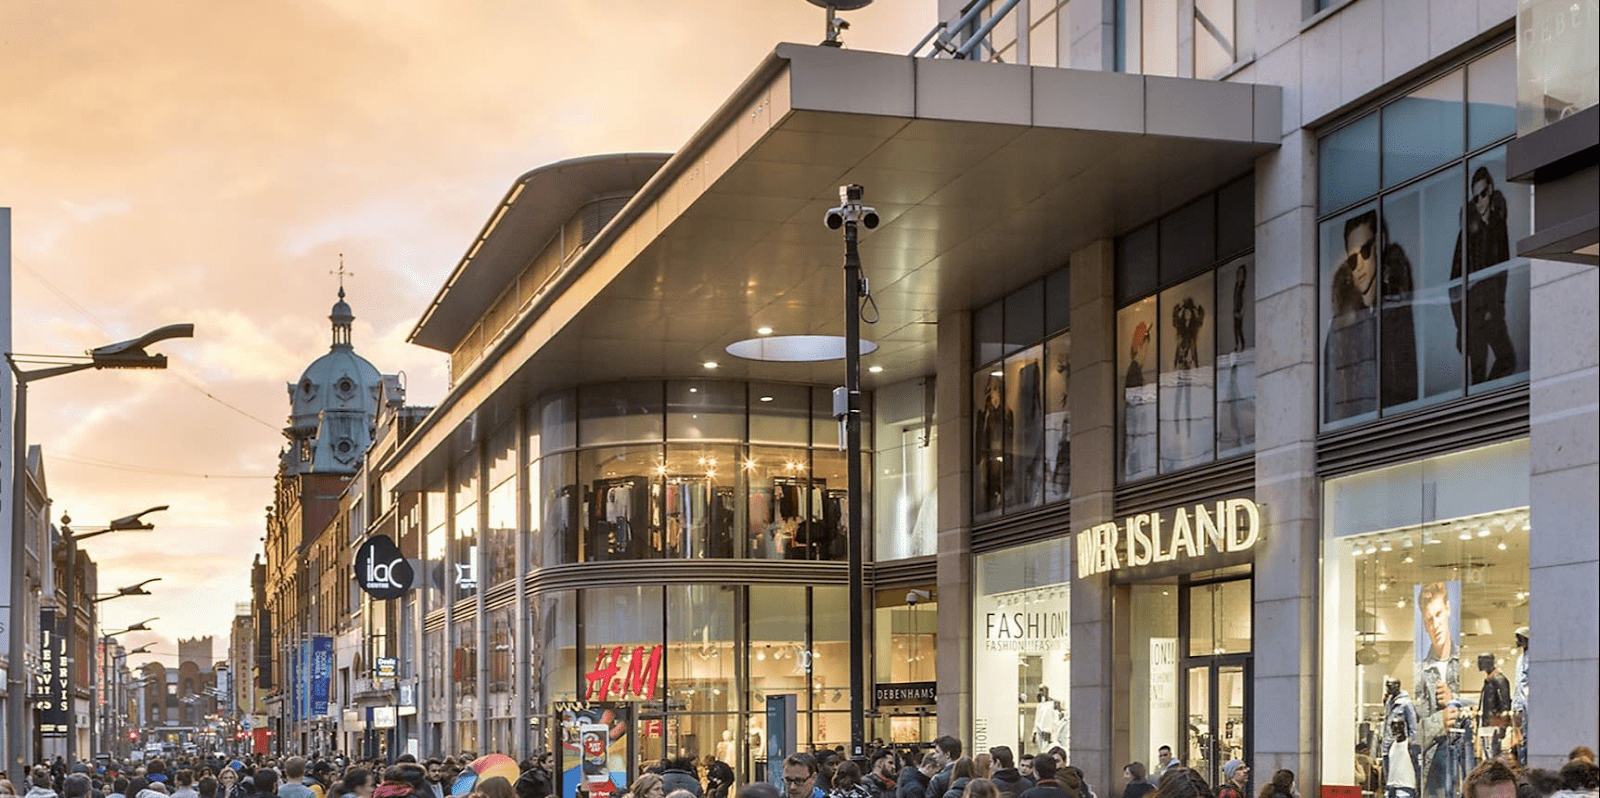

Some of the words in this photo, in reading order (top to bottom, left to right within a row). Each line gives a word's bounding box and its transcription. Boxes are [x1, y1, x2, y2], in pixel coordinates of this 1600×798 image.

[1126, 498, 1260, 567] ISLAND
[366, 545, 403, 588] ilac
[59, 638, 68, 711] JERVIS
[585, 644, 662, 701] H&M
[876, 688, 935, 700] DEBENHAMS
